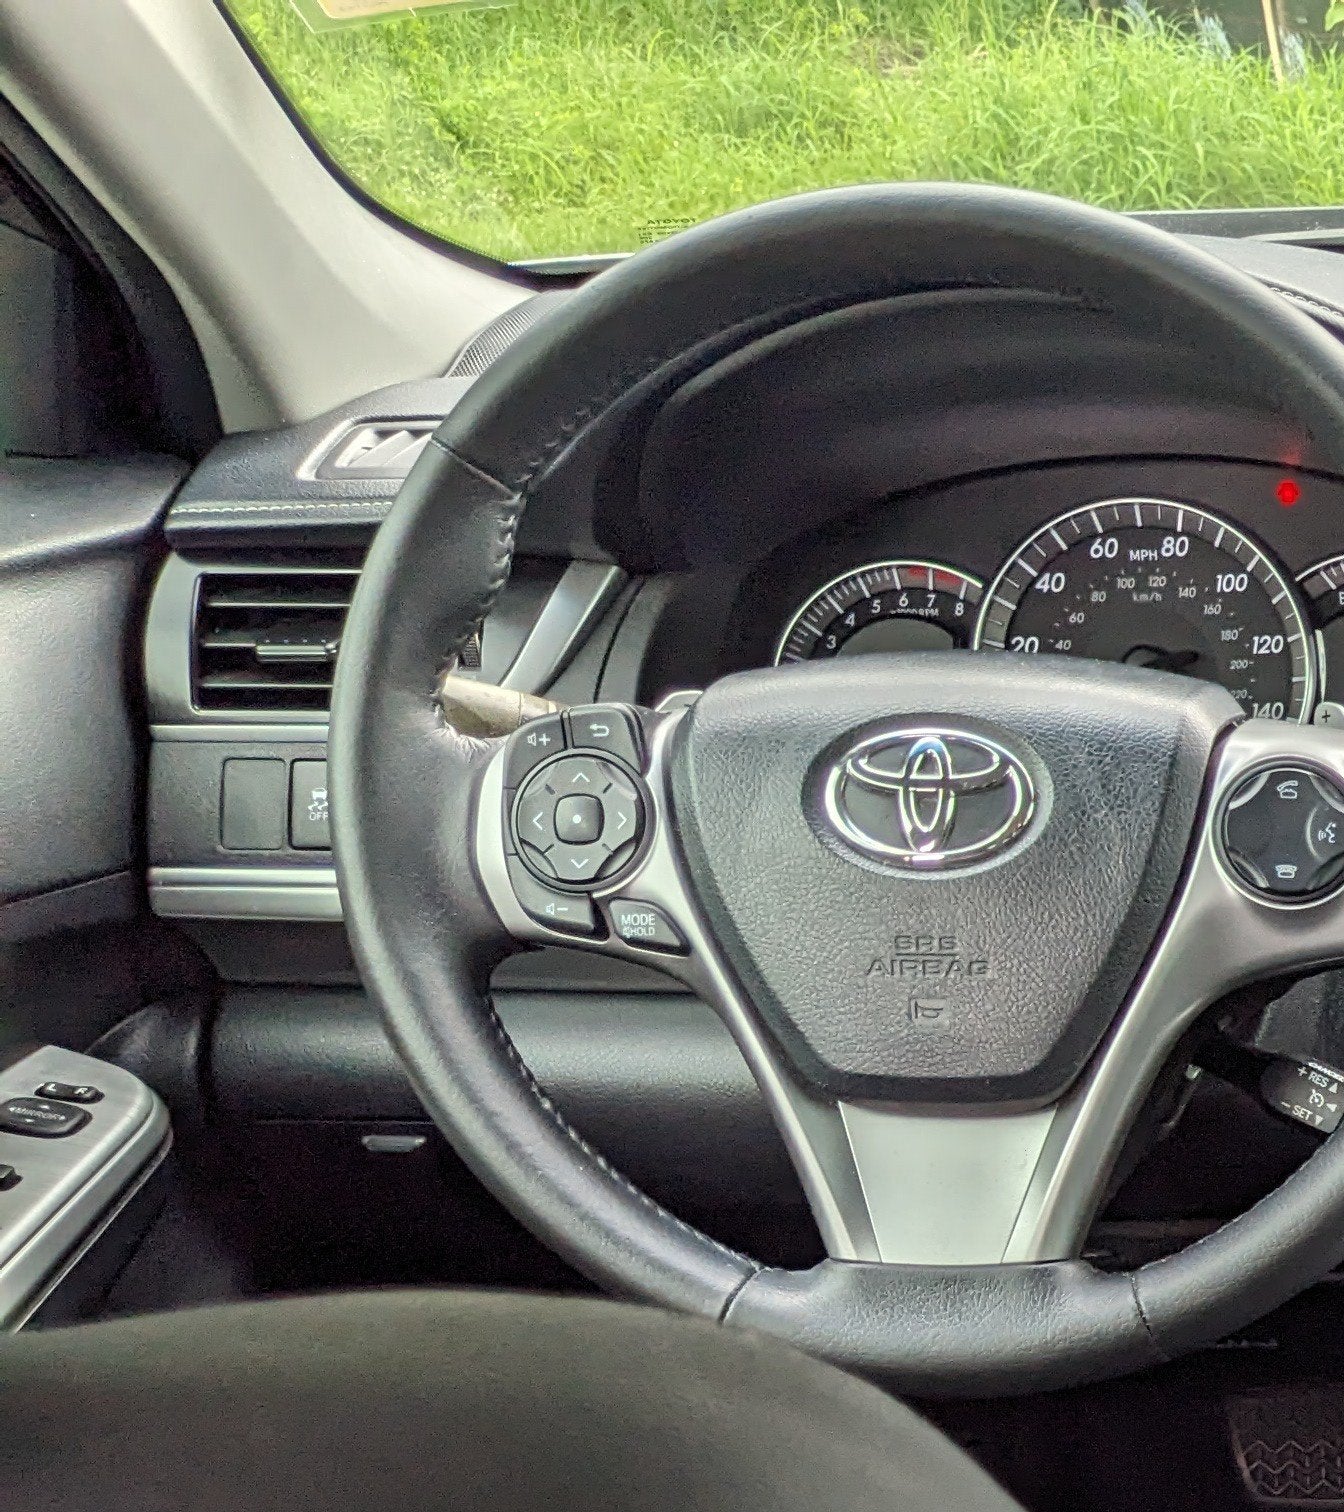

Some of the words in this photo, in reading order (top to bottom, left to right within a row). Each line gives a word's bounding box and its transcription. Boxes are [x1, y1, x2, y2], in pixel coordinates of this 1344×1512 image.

[1089, 537, 1119, 559] 60
[1161, 536, 1189, 558] 80
[1129, 548, 1158, 562] MPH
[1035, 573, 1065, 593] 40
[1117, 577, 1135, 589] 100
[1148, 575, 1167, 588] 120
[1216, 573, 1248, 593] 100
[899, 592, 909, 607] 6
[1091, 590, 1106, 602] 80
[1132, 591, 1162, 602] km/h
[1178, 587, 1197, 598] 140
[871, 600, 881, 613] 5
[926, 594, 937, 608] 7
[954, 602, 964, 616] 8
[1204, 604, 1222, 616] 160
[845, 612, 855, 626] 4
[1068, 612, 1085, 624] 60
[826, 634, 837, 649] 3
[1221, 629, 1239, 641] 180
[1010, 636, 1040, 653] 20
[1055, 639, 1072, 651] 40
[1252, 635, 1284, 655] 120
[1252, 701, 1284, 720] 140
[621, 913, 656, 926] MODE
[630, 926, 655, 936] HOLD
[1308, 1071, 1329, 1088] RES
[1291, 1104, 1313, 1121] SET
